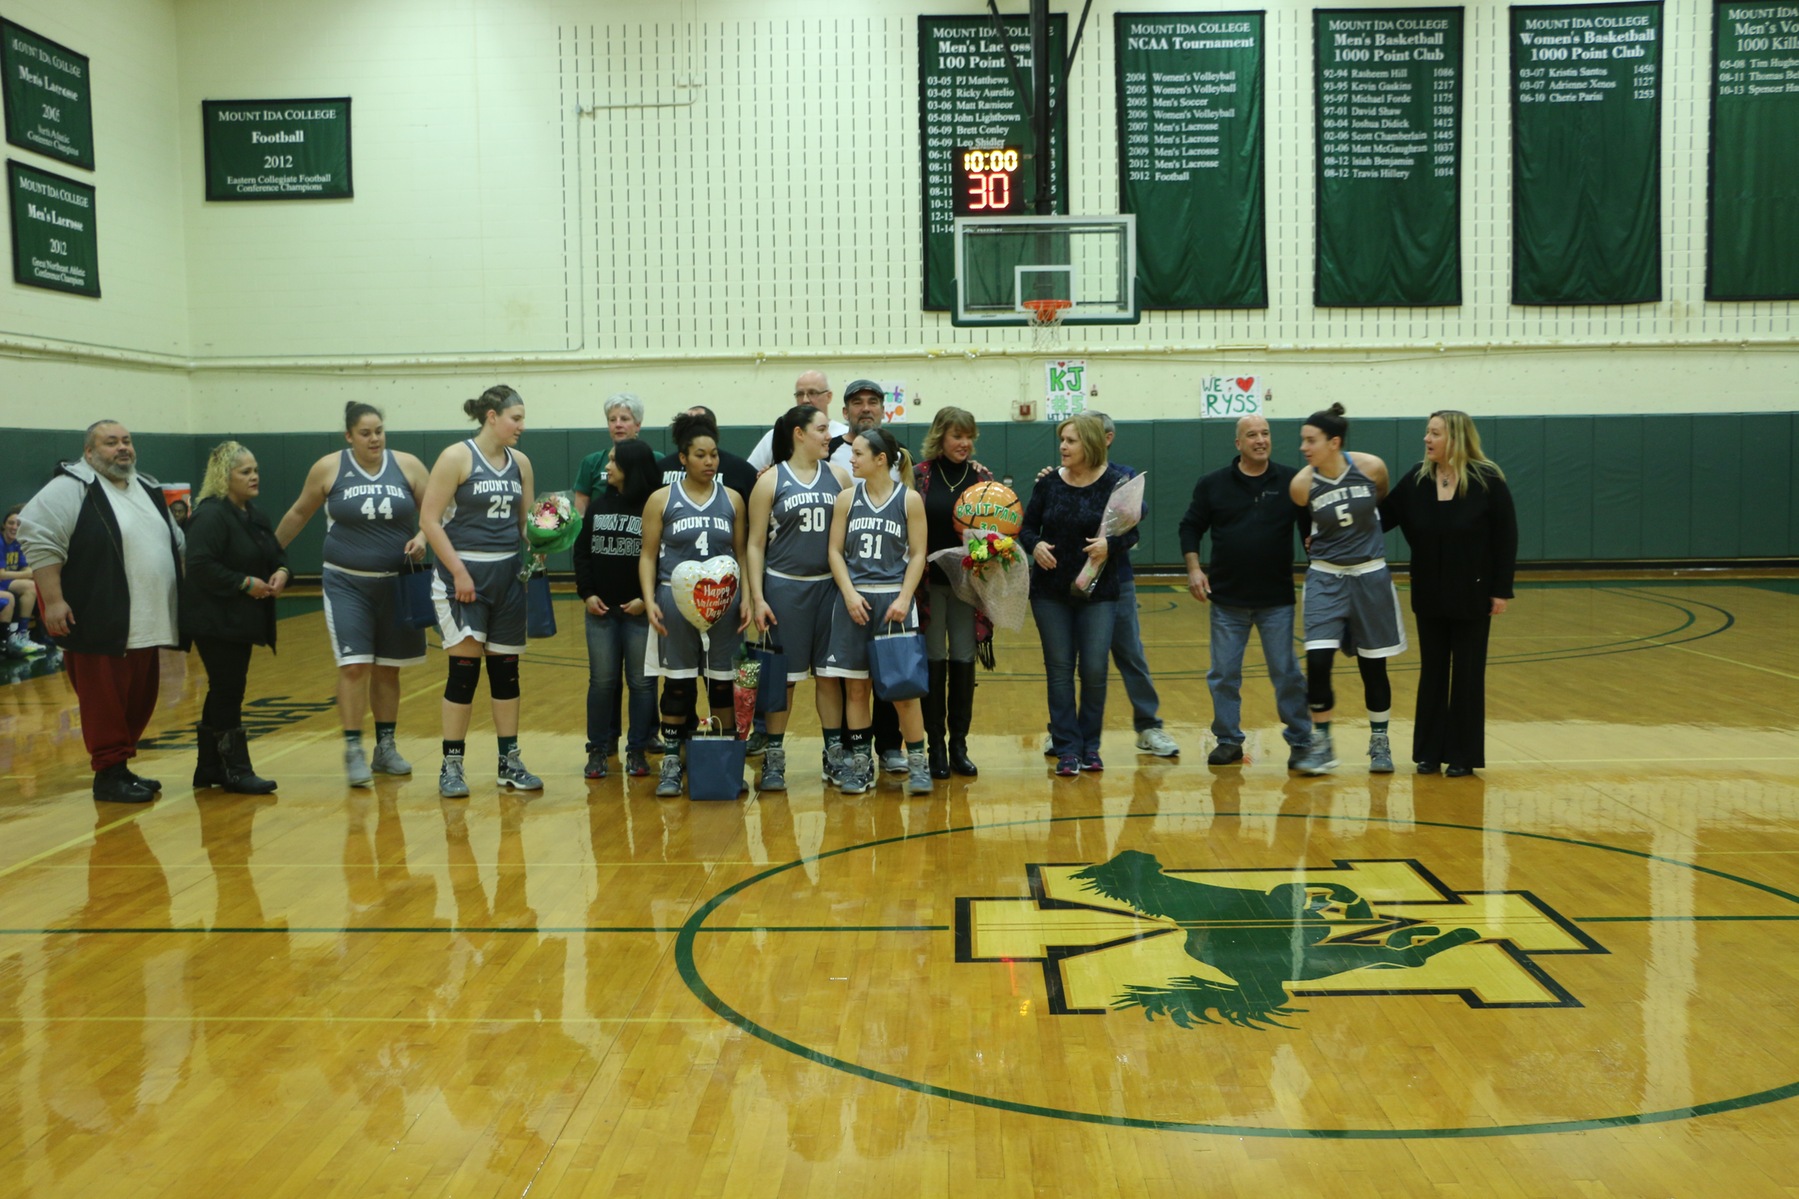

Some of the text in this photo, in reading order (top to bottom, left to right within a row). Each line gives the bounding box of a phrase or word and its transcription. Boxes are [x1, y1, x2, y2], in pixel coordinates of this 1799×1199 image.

[1728, 6, 1799, 20] MOUNT IDA
[1131, 22, 1251, 35] MOUNT IDA COLLEGE
[1328, 19, 1448, 31] MOUNT IDA COLLEGE
[1525, 16, 1649, 30] MOUNT IDA COLLEGE
[933, 27, 976, 38] MOUNT
[1334, 32, 1444, 46] Men's Basketball
[1520, 28, 1656, 45] Women's Basketball
[938, 40, 976, 53] Men's
[1128, 36, 1254, 50] NCAA Tournament
[1737, 37, 1769, 52] 1000
[1334, 48, 1445, 62] 1000 Point Club
[1531, 44, 1645, 61] 1000 Point Club
[938, 56, 1006, 69] 100 Point
[18, 65, 78, 101] Men's Lacrosse
[927, 76, 1009, 86] 03-05 PJ Matthews
[1152, 73, 1191, 82] Women's
[1193, 72, 1236, 83] Volleyball
[927, 88, 952, 98] 03-05
[956, 88, 981, 99] Ricky
[1152, 85, 1192, 94] Women's
[1193, 84, 1236, 95] Volleyball
[927, 100, 977, 110] 03-06 Matt
[1153, 97, 1178, 106] Men's
[1179, 97, 1209, 106] Soccer
[218, 109, 337, 121] MOUNT IDA COLLEGE
[953, 113, 974, 123] John
[975, 113, 1021, 124] Lightbown
[1153, 110, 1191, 119] Women's
[1193, 109, 1235, 120] Volleyball
[928, 125, 1010, 136] 06-09 Brett Conley
[1153, 122, 1179, 131] Men's
[1182, 122, 1219, 131] Lacrosse
[252, 130, 304, 143] Football
[928, 138, 953, 147] 06-09
[957, 138, 973, 147] Leo
[1154, 135, 1180, 144] Men's
[1182, 135, 1219, 144] Lacrosse
[1154, 147, 1179, 156] Men's
[1182, 147, 1219, 156] Lacrosse
[264, 156, 293, 168] 2012
[964, 150, 1018, 172] 10:00
[1128, 159, 1219, 168] 2012 Men's Lacrosse
[227, 174, 331, 186] Eastern Collegiate Football
[1129, 171, 1190, 180] 2012 Football
[19, 176, 89, 208] MOUNT IDA COLLEGE
[237, 183, 322, 192] Conference Champions
[968, 173, 1009, 209] 30
[28, 203, 83, 231] Men's Lacrosse
[50, 238, 67, 255] 2012
[1050, 366, 1084, 392] KJ
[1202, 377, 1222, 392] WE
[1206, 394, 1257, 415] RYSS
[343, 484, 405, 500] MOUNT IDA
[473, 479, 509, 495] MOUNT
[361, 497, 393, 520] 44
[487, 495, 514, 519] 25
[784, 492, 820, 512] MOUNT
[799, 507, 826, 532] 30
[1335, 503, 1353, 527] 5
[672, 517, 730, 535] MOUNT IDA
[848, 517, 901, 538] MOUNT IDA
[695, 531, 709, 556] 4
[859, 533, 882, 559] 31
[704, 584, 730, 599] Happy
